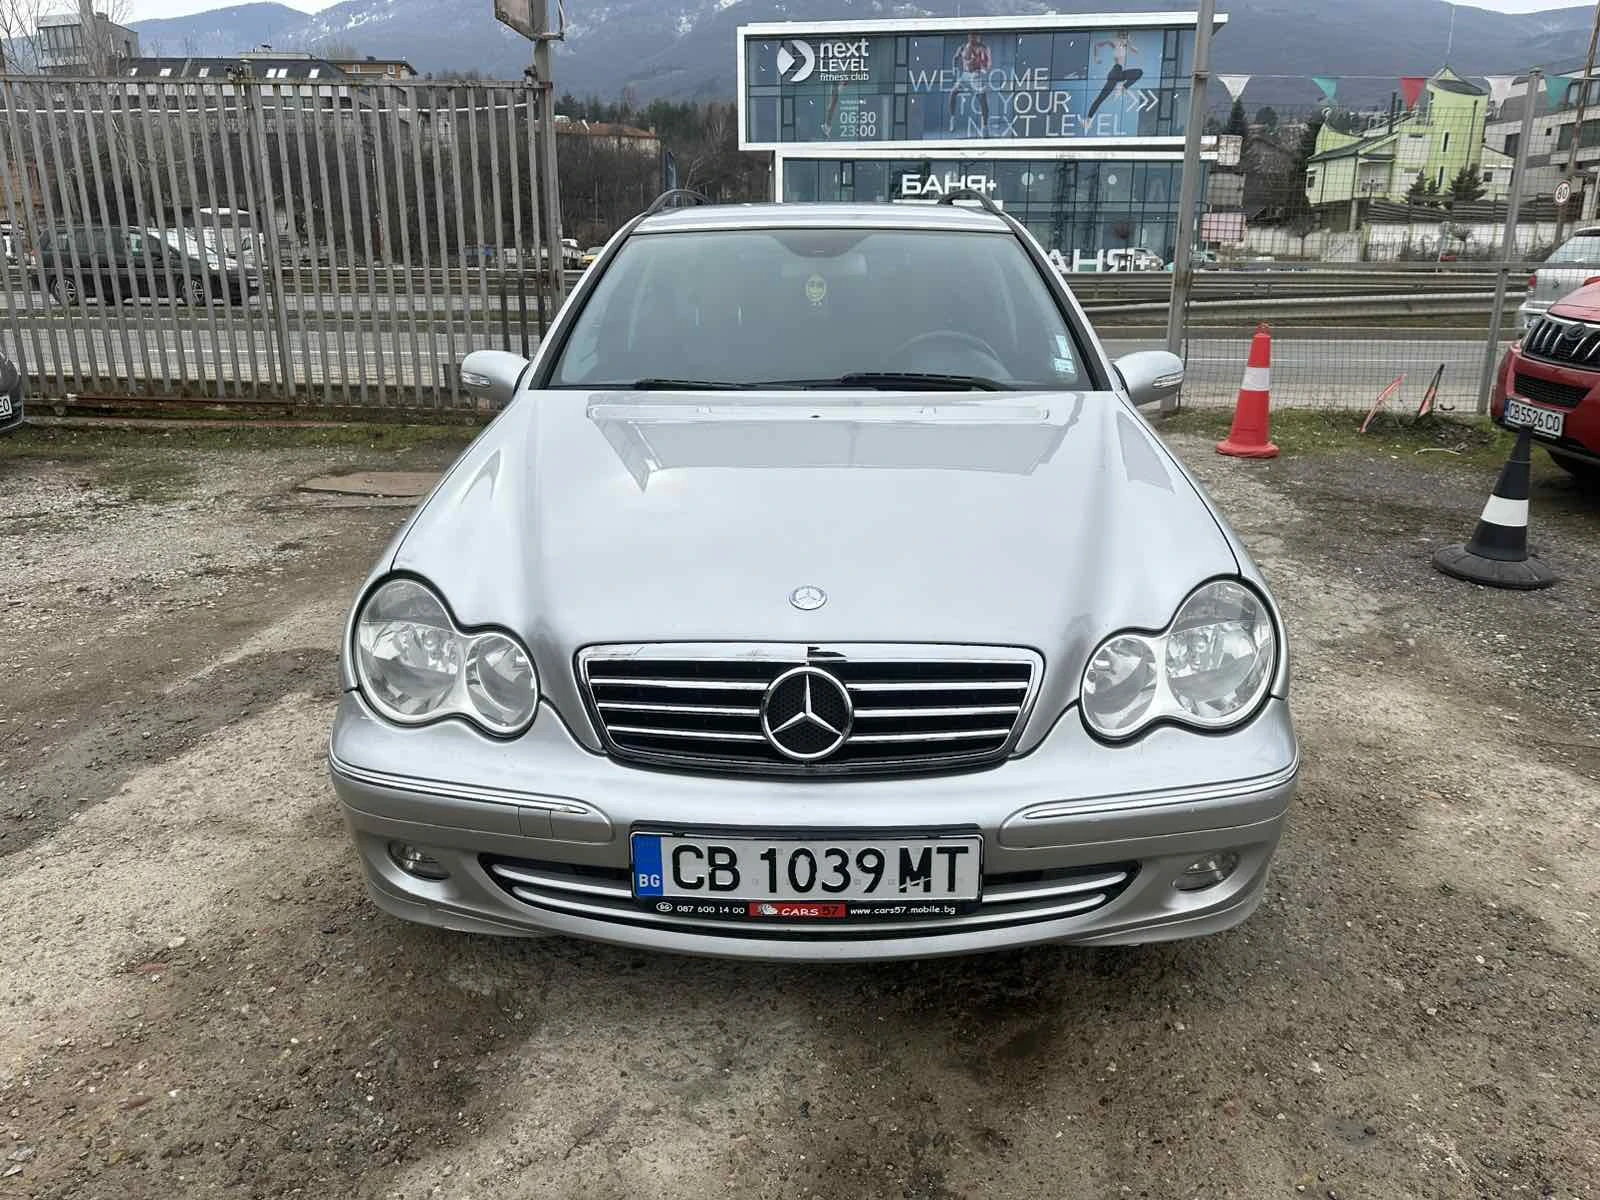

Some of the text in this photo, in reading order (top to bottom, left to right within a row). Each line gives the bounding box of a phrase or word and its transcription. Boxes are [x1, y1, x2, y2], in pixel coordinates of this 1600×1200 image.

[820, 38, 869, 58] next
[820, 59, 869, 72] LEVEL
[820, 72, 870, 81] fitness club
[1001, 91, 1072, 114] YOUR
[840, 111, 876, 124] 06:30
[840, 124, 876, 137] 23:00
[967, 113, 1127, 138] NEXT LEVEL
[1048, 248, 1152, 273] АНЯ+
[1509, 403, 1520, 420] CB
[1520, 406, 1544, 428] 5526
[672, 845, 969, 894] CB 1039 MT
[639, 873, 660, 888] BG
[677, 905, 694, 913] 087
[697, 905, 715, 913] 600
[719, 906, 729, 914] 14
[781, 906, 838, 917] CARS 57
